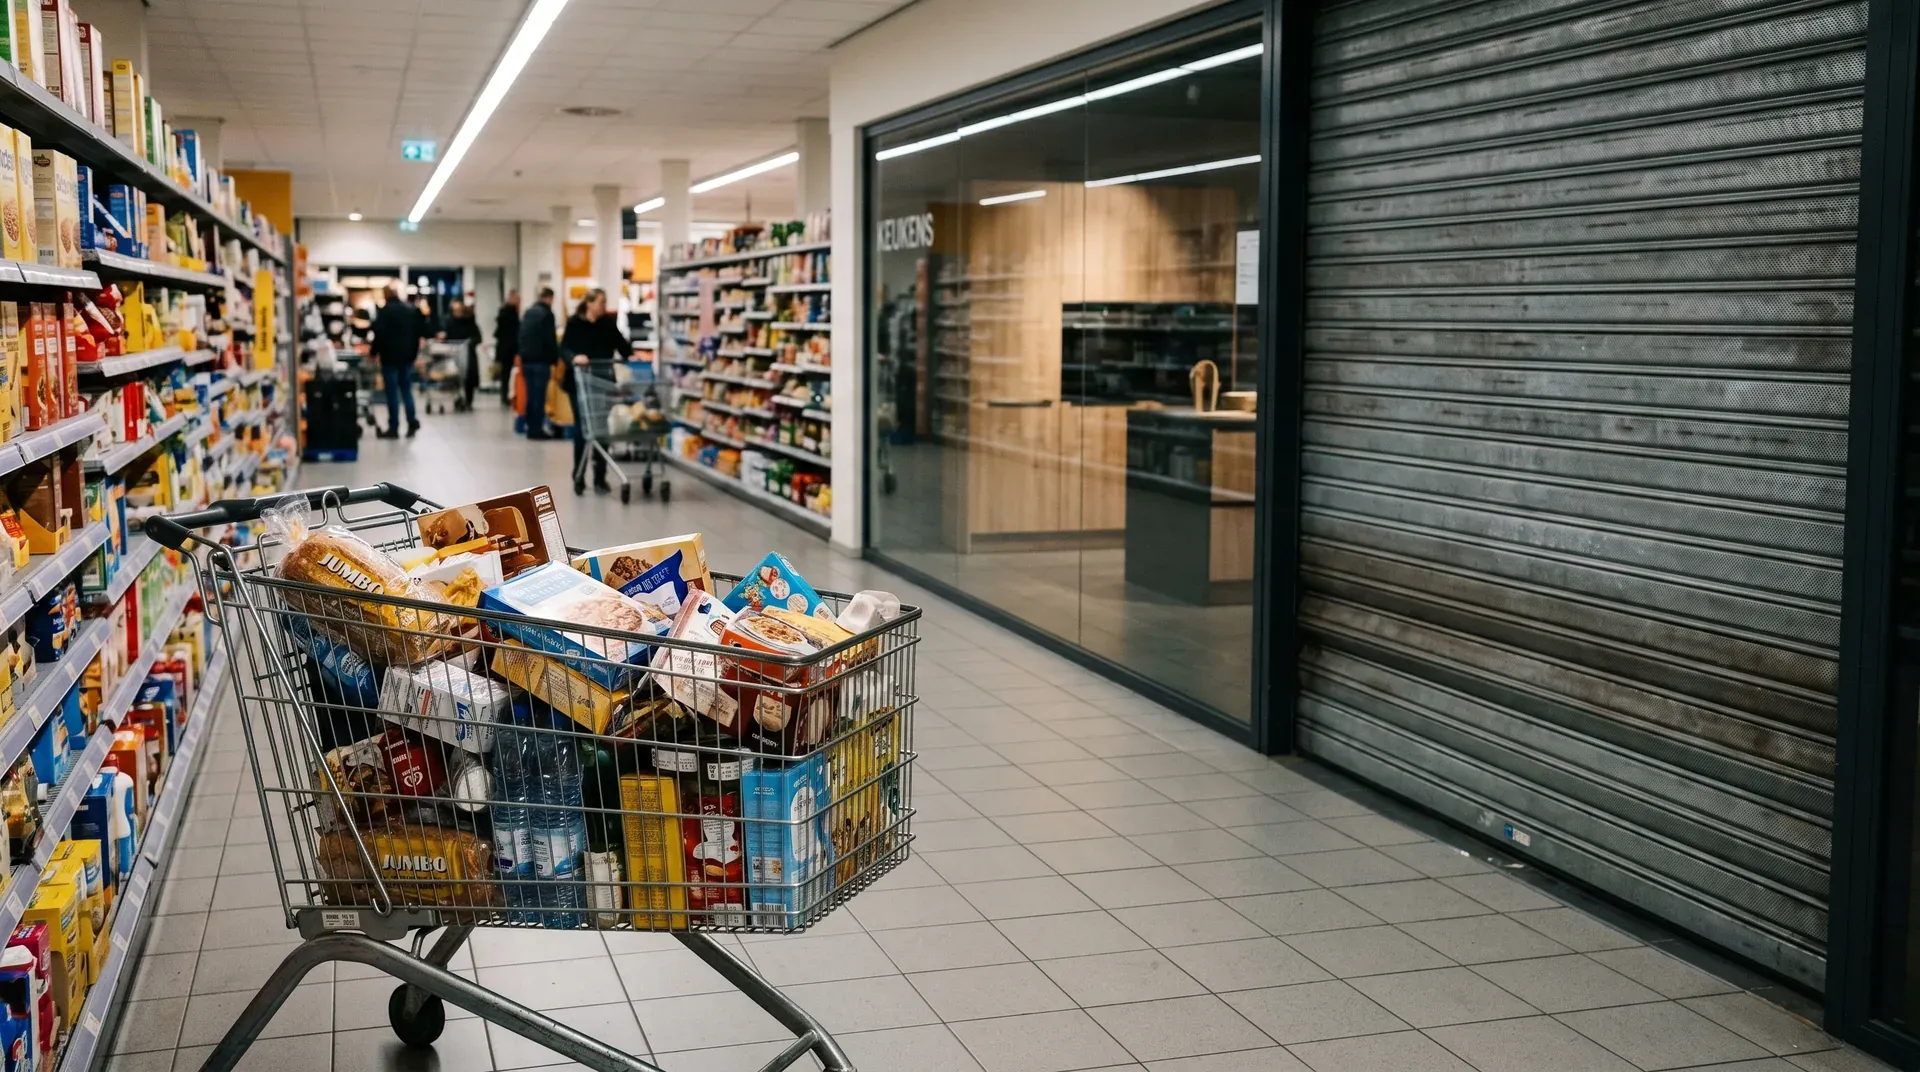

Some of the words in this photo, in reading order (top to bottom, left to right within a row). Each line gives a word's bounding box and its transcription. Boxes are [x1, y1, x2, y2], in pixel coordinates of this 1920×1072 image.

[877, 212, 934, 252] KEUKENS
[317, 552, 385, 595] JUMBO
[382, 854, 447, 873] JUMBO
